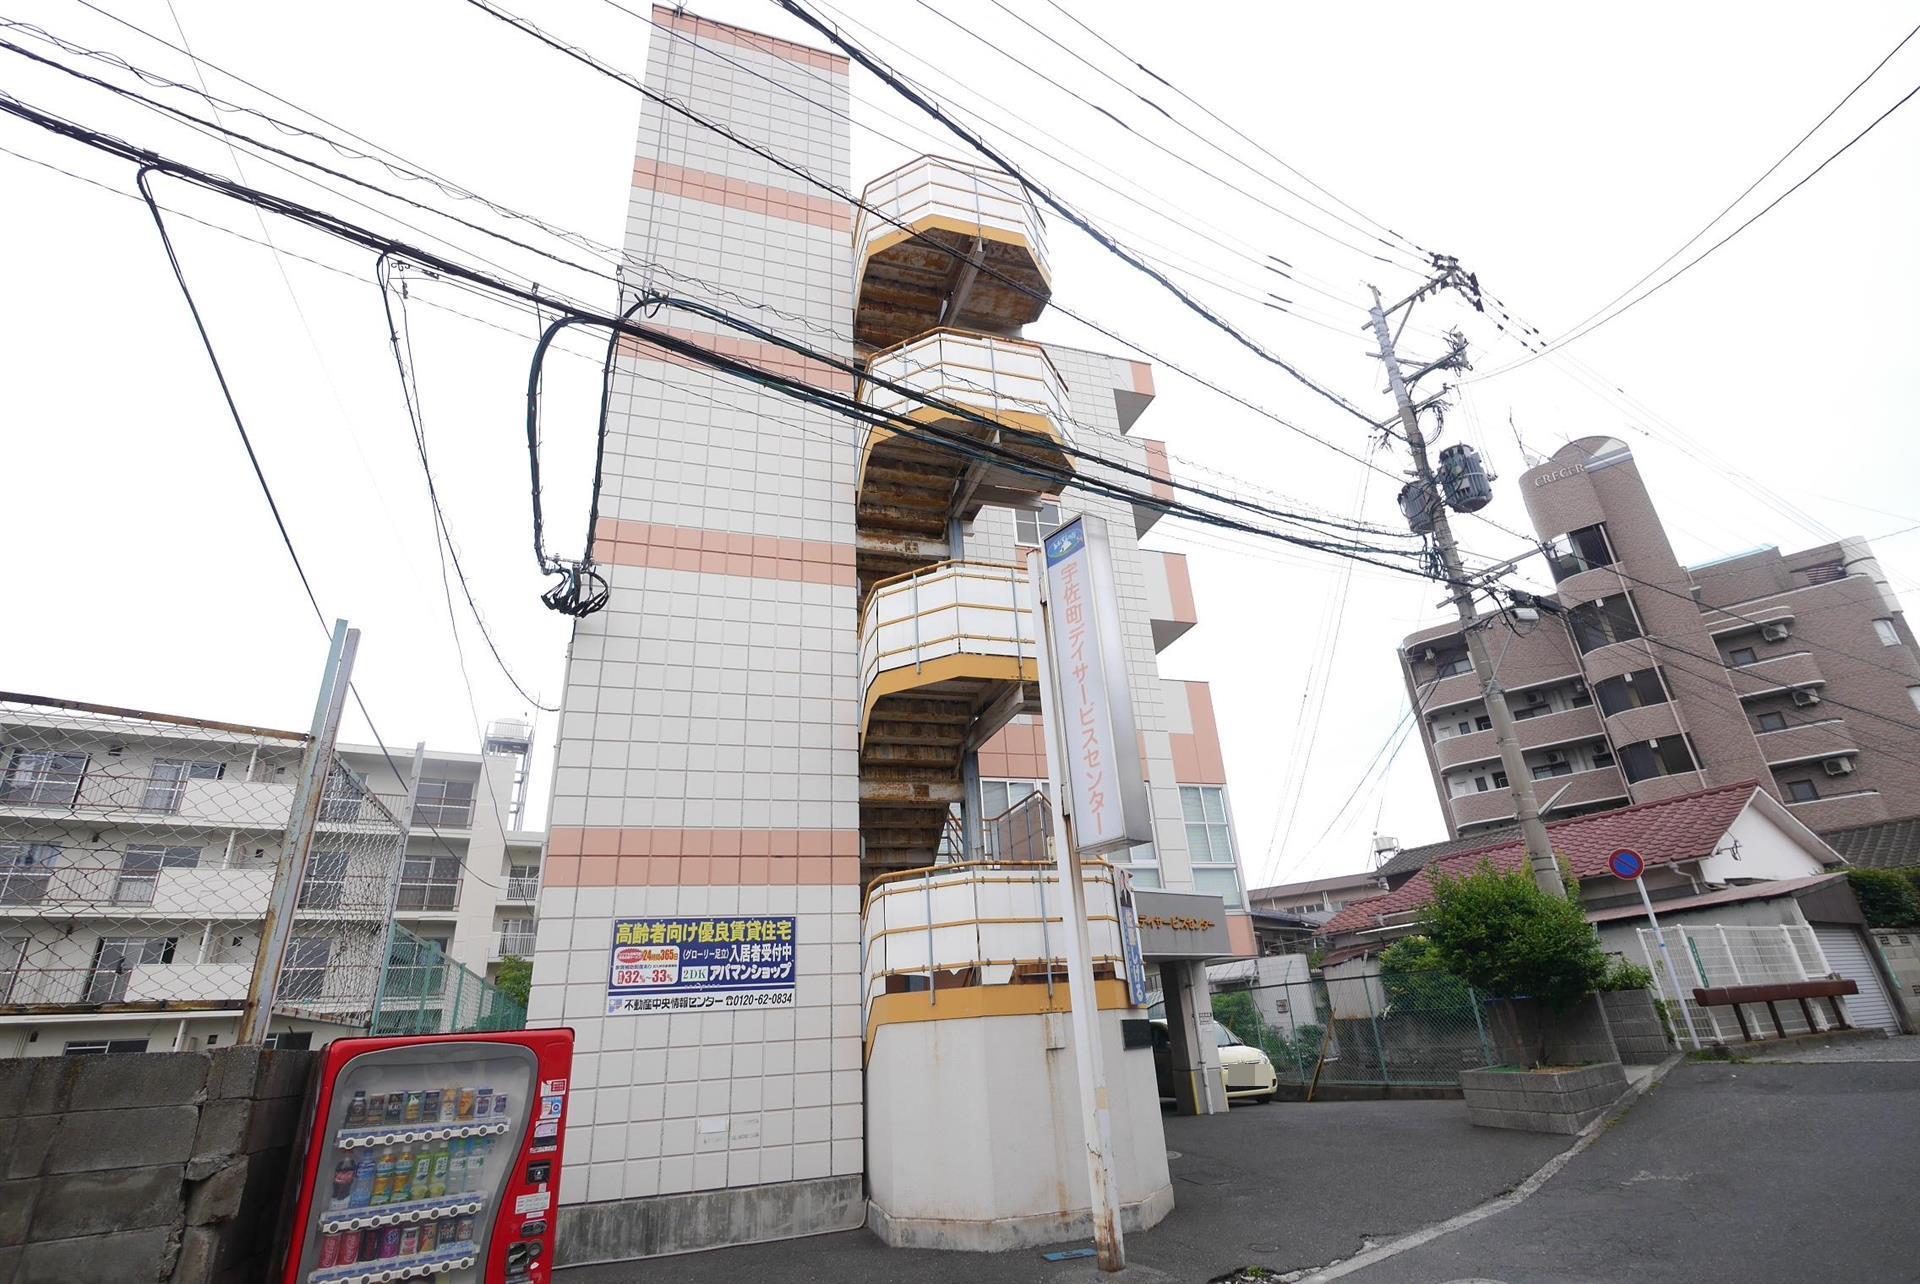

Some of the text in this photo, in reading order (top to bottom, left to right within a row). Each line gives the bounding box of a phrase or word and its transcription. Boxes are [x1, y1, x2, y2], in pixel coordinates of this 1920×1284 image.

[1534, 463, 1585, 488] CRECER
[1060, 560, 1105, 836] 宇佐町デイサービスセンター
[616, 920, 791, 944] 高齢者向け優良賃貸住宅
[729, 942, 792, 963] 入居者受付中
[683, 968, 706, 980] 2DK
[709, 961, 792, 982] アパマンショップ
[624, 996, 724, 1011] 不動産中央情報センター
